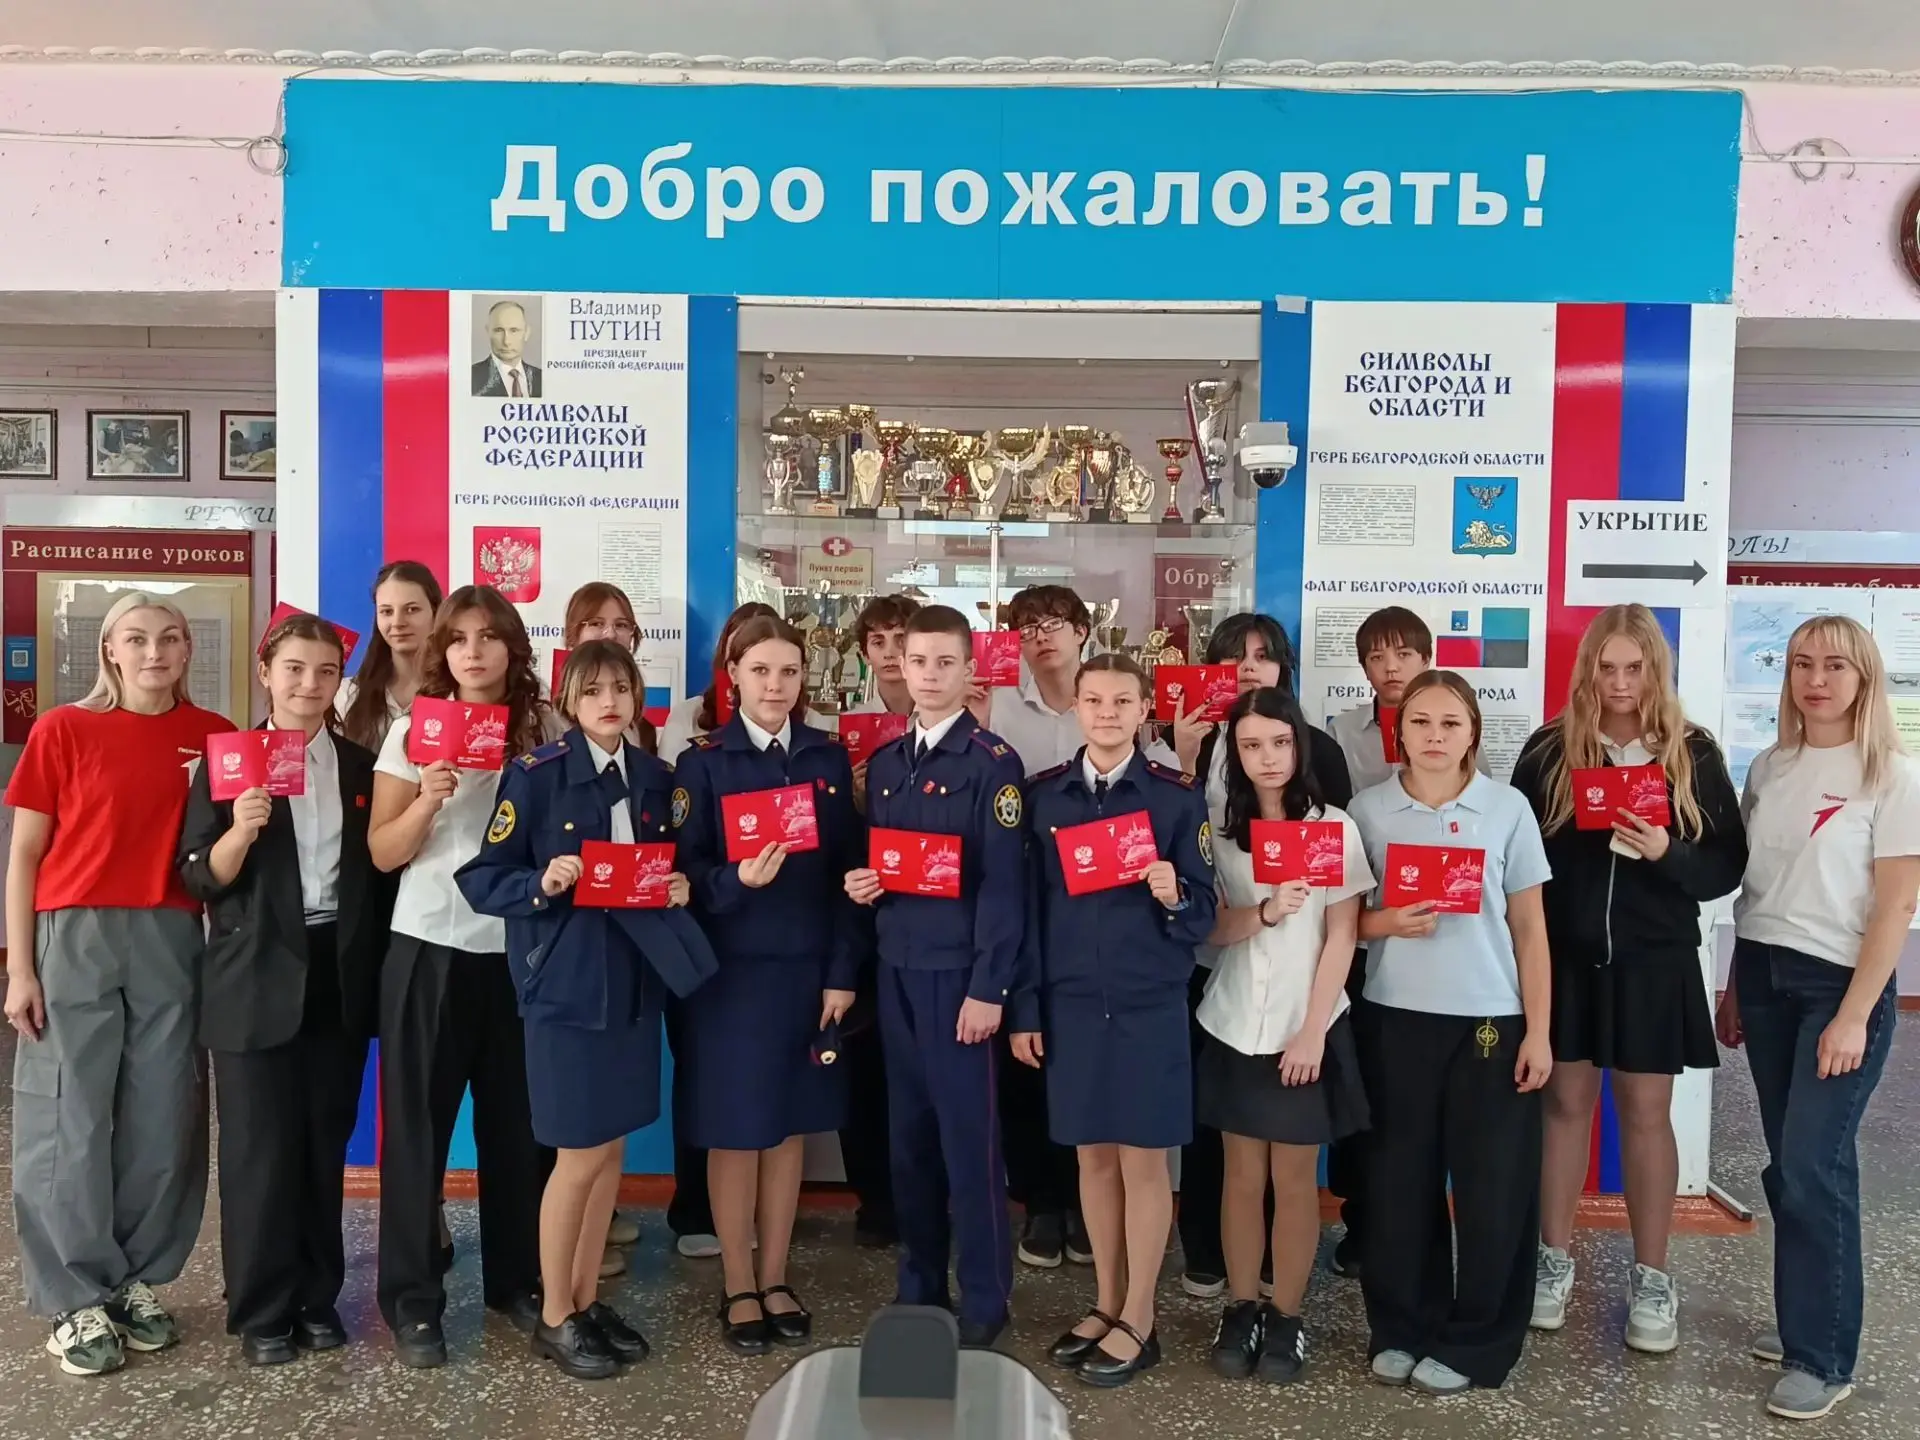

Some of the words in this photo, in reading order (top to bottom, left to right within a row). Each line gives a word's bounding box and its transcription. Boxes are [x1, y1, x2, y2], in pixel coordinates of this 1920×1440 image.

[490, 142, 825, 239] Добро
[870, 154, 1546, 227] пожаловать!
[570, 298, 662, 320] Владимир
[570, 320, 661, 341] ПУТИН
[584, 349, 645, 359] ПРЕЗИДЕНТ
[1360, 352, 1491, 372] СИМВОЛЫ
[547, 359, 615, 370] РОССИЙСКОЙ
[617, 361, 684, 372] ФЕДЕРАЦИИ
[1345, 374, 1486, 396] БЕЛГОРОДА
[1495, 376, 1511, 395] И
[500, 403, 628, 425] СИМВОЛЫ
[1369, 397, 1484, 417] ОБЛАСТИ
[483, 422, 647, 447] РОССИЙСКОЙ
[485, 448, 643, 473] ФЕДЕРАЦИИ
[1310, 451, 1348, 464] ГЕРБ
[1351, 451, 1469, 466] БЕЛГОРОДСКОЙ
[1473, 453, 1544, 465] ОБЛАСТИ
[455, 494, 489, 505] ГЕРБ
[493, 495, 585, 507] РОССИЙСКОЙ
[589, 497, 679, 511] ФЕДЕРАЦИИ
[1578, 511, 1708, 532] УКРЫТИЕ
[10, 540, 153, 560] Расписание
[162, 548, 245, 564] уроков
[1304, 580, 1347, 592] ФЛАГ
[1350, 580, 1467, 595] БЕЛГОРОДСКОЙ
[1472, 583, 1543, 595] ОБЛАСТИ
[1327, 685, 1365, 698] ГЕРБ
